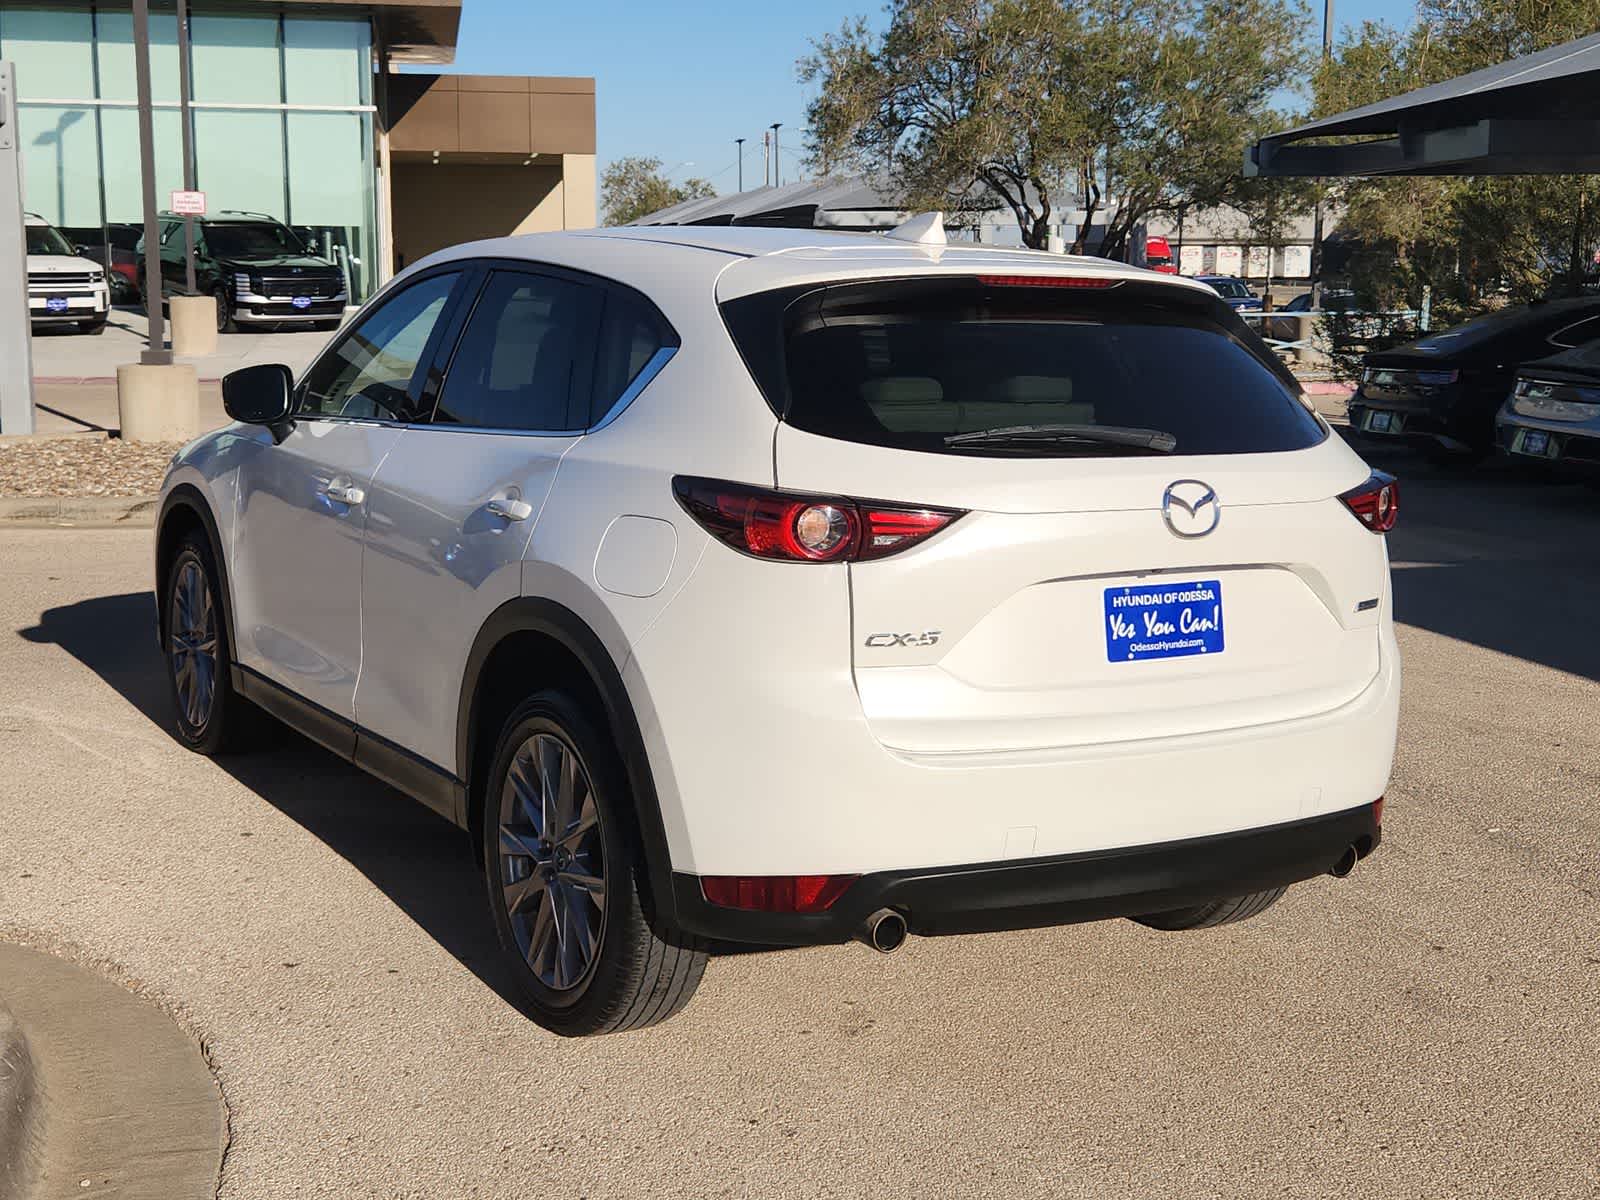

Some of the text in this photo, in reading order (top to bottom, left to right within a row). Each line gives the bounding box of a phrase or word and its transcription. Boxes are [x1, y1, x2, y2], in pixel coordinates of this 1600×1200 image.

[1113, 589, 1215, 608] HYUNDAI OF ODESSA
[1109, 604, 1219, 640] Yes You Can!
[864, 631, 942, 648] CX-5
[1130, 638, 1204, 652] OdessaHyundai.com
